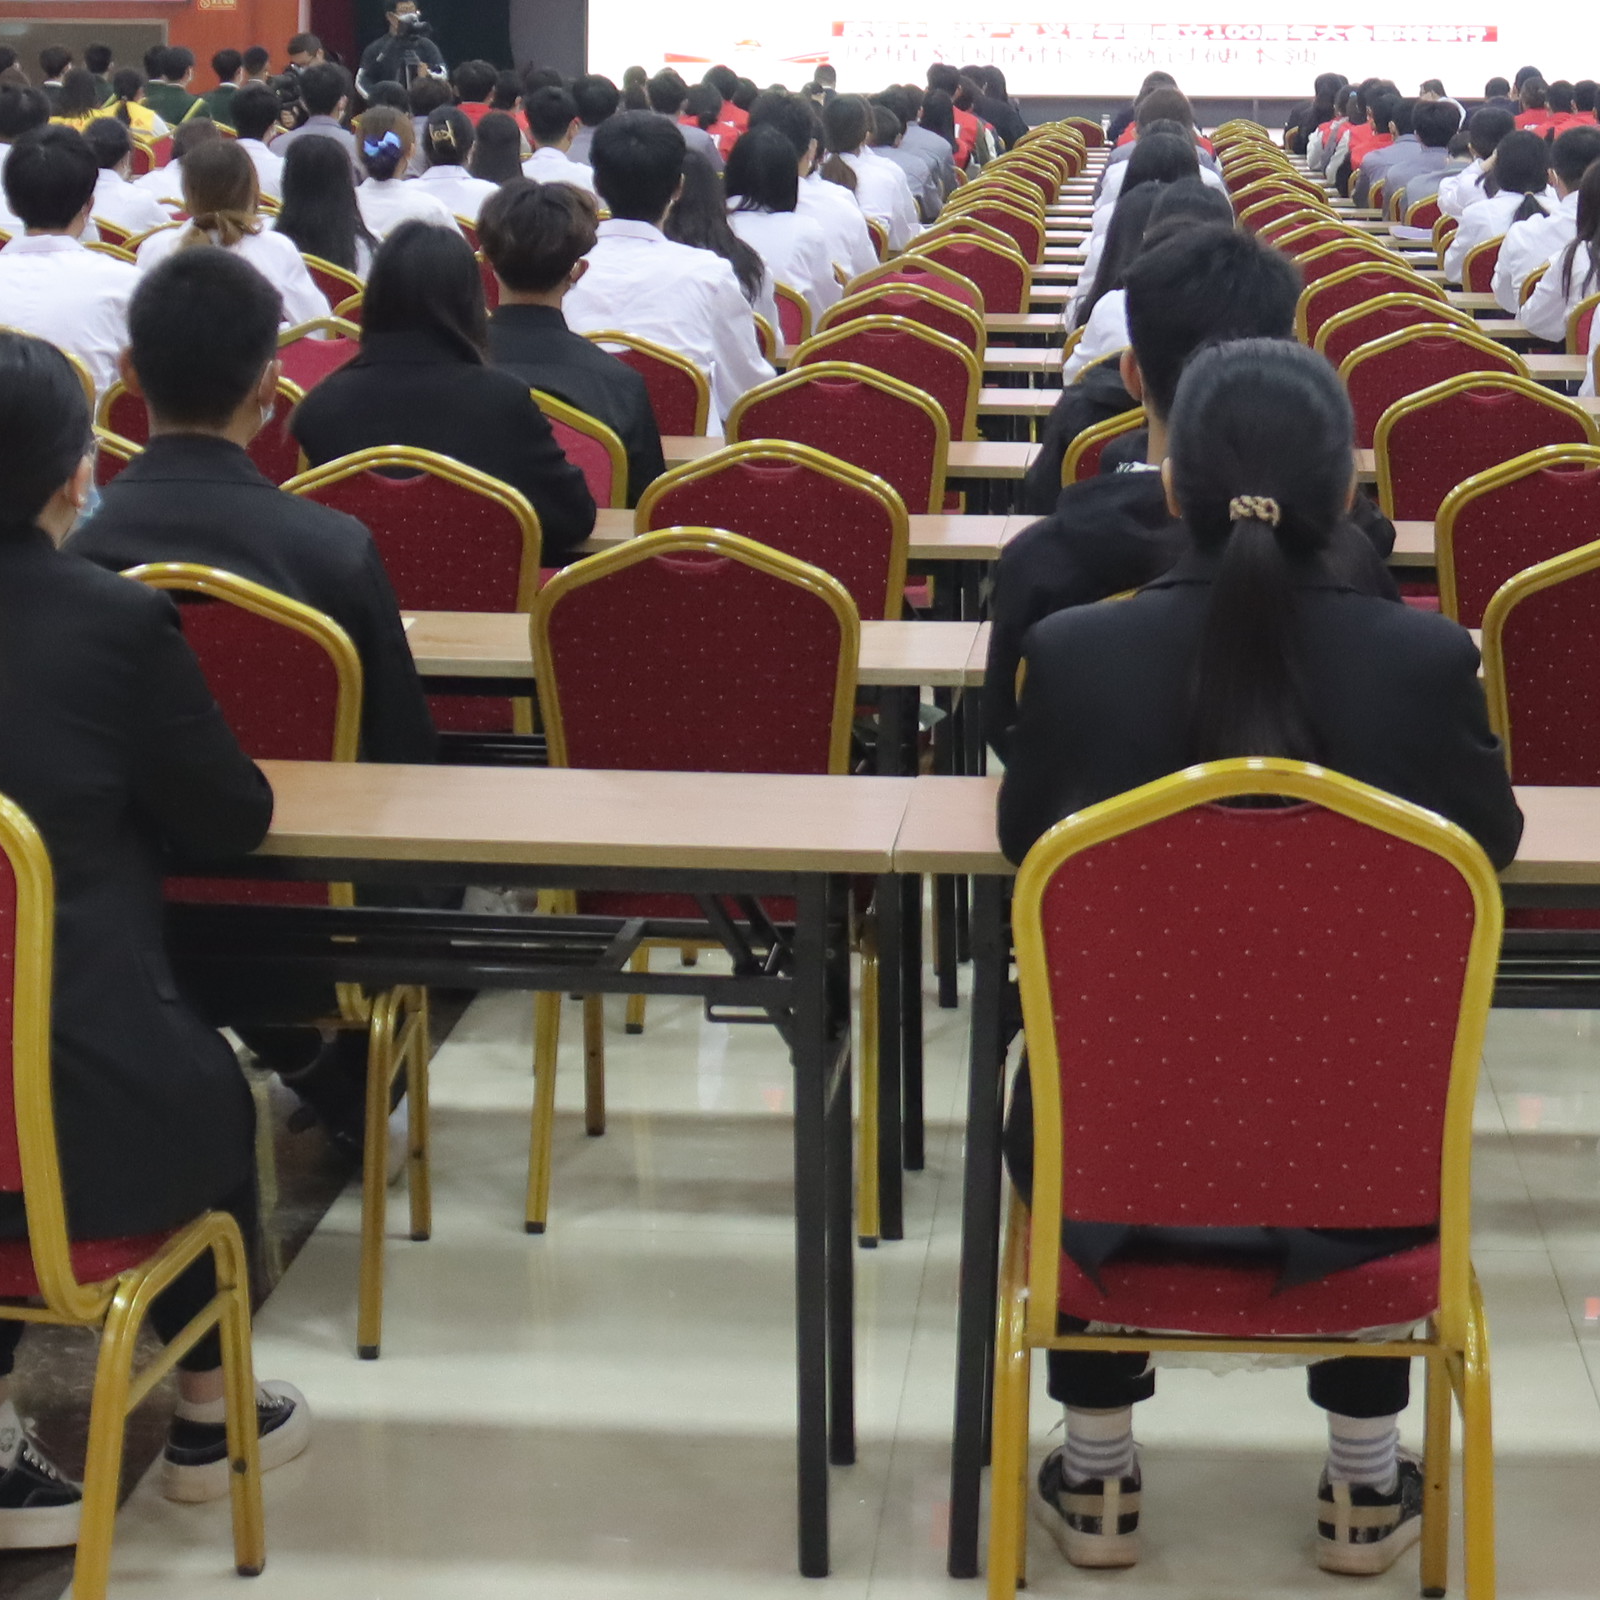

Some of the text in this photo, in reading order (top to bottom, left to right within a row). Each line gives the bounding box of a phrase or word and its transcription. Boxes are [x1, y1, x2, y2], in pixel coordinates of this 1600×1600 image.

[844, 21, 1486, 41] 庆祝中共产主义青年团成立100周年大会即将举行
